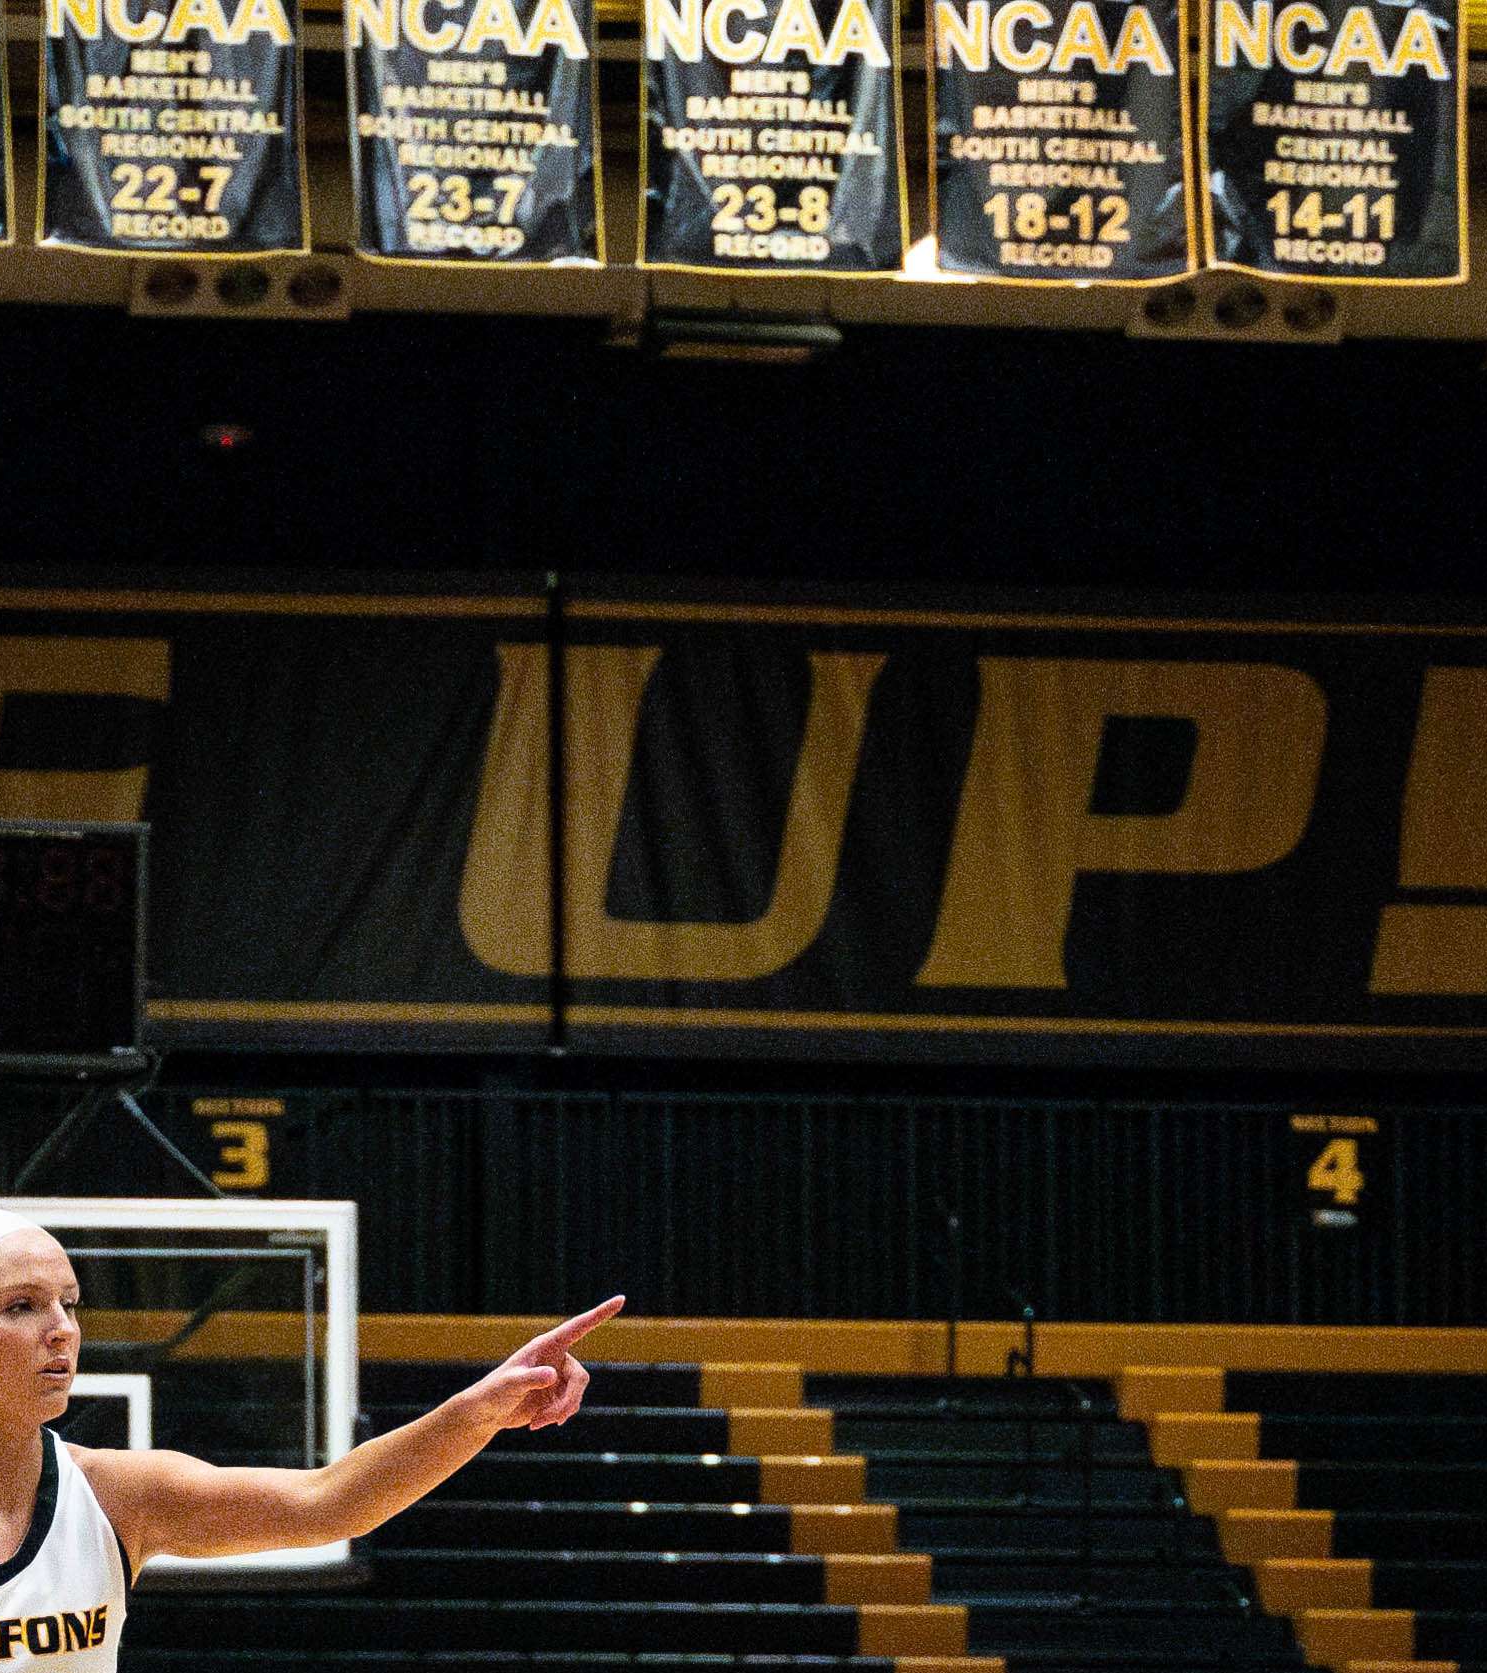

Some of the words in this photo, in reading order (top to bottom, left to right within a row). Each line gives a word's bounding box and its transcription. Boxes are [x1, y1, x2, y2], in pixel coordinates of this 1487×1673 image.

[46, 0, 295, 47] NCAA
[347, 0, 589, 60] NCAA
[645, 0, 892, 69] NCAA
[937, 0, 1174, 76] NCAA
[1214, 0, 1452, 81] NCAA
[131, 50, 213, 75] MEN'S
[428, 60, 507, 86] MEN'S
[86, 75, 259, 103] BASKETBALL
[731, 70, 811, 96] MEN'S
[1018, 80, 1096, 104] MEN'S
[1293, 80, 1370, 106] MEN'S
[384, 86, 550, 114] BASKETBALL
[687, 97, 854, 124] BASKETBALL
[59, 105, 152, 132] SOUTH
[158, 107, 285, 135] CENTRAL
[358, 116, 447, 141] SOUTH
[454, 119, 580, 147] CENTRAL
[973, 106, 1137, 132] BASKETBALL
[1252, 101, 1414, 134] BASKETBALL
[101, 133, 244, 161] REGIONAL
[662, 127, 751, 152] SOUTH
[758, 128, 882, 156] CENTRAL
[951, 136, 1037, 162] SOUTH
[1044, 138, 1165, 165] CENTRAL
[1275, 135, 1397, 164] CENTRAL
[399, 144, 537, 173] REGIONAL
[702, 154, 839, 181] REGIONAL
[110, 163, 231, 212] 22-7
[989, 163, 1124, 190] REGIONAL
[1264, 160, 1399, 190] REGIONAL
[408, 174, 527, 225] 23-7
[711, 184, 831, 235] 23-8
[111, 214, 229, 240] RECORD
[983, 193, 1131, 243] 18-12
[1266, 190, 1396, 241] 14-11
[408, 225, 526, 252] RECORD
[713, 234, 831, 262] RECORD
[1273, 238, 1386, 266] RECORD
[1000, 243, 1114, 269] RECORD
[210, 1120, 271, 1189] 3
[1306, 1138, 1365, 1205] 4
